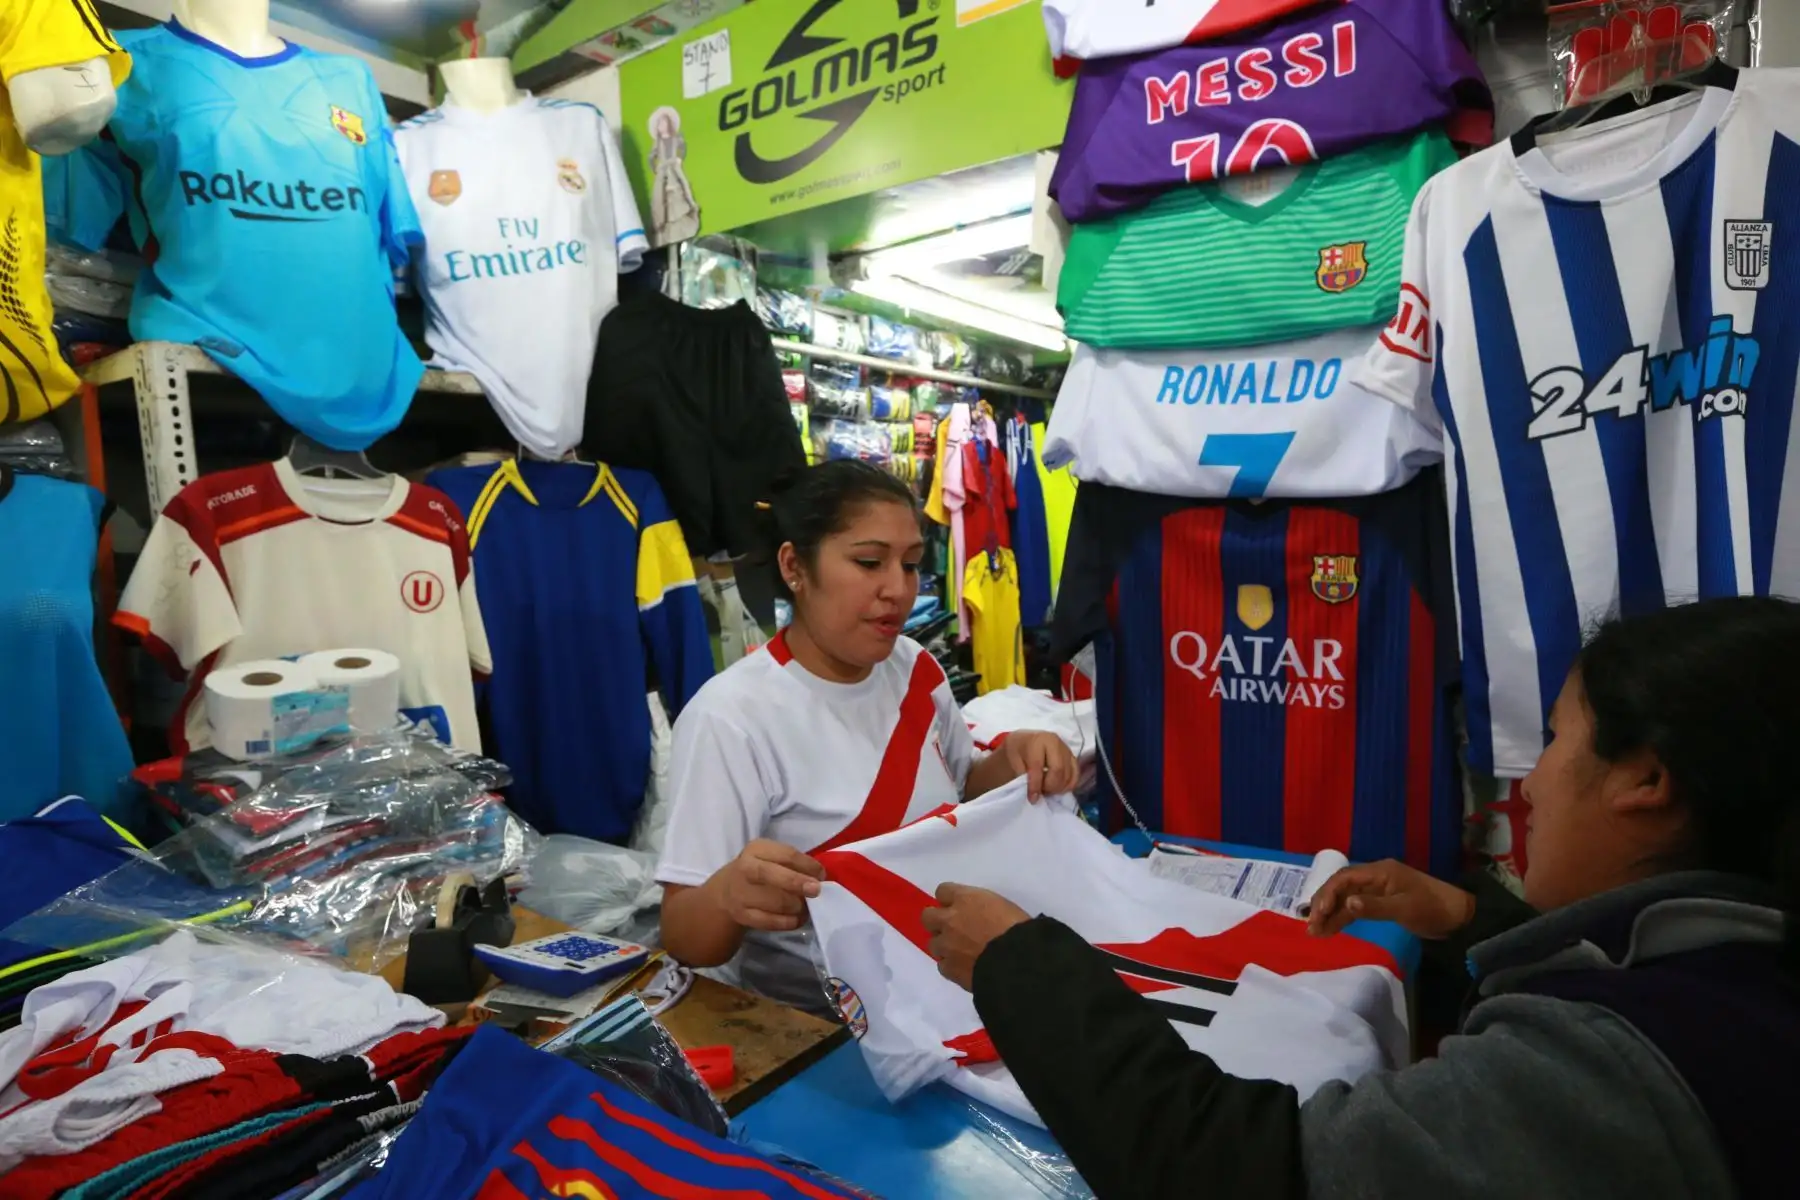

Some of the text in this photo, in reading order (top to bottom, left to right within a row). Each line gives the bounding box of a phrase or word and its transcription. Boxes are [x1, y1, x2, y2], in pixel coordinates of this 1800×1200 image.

[684, 33, 729, 66] STAND
[698, 61, 717, 92] 7
[718, 16, 939, 131] GOLMAS
[882, 62, 946, 104] sport
[1144, 20, 1356, 124] MESSI
[178, 168, 368, 214] Rakuten
[497, 217, 538, 240] Fly
[1730, 224, 1768, 232] ALIANZA
[1740, 278, 1756, 287] 1901
[1156, 358, 1342, 405] RONALDO
[1198, 428, 1298, 498] 7
[412, 579, 433, 607] U
[1170, 630, 1345, 681] QATAR
[1209, 676, 1346, 710] AIRWAYS
